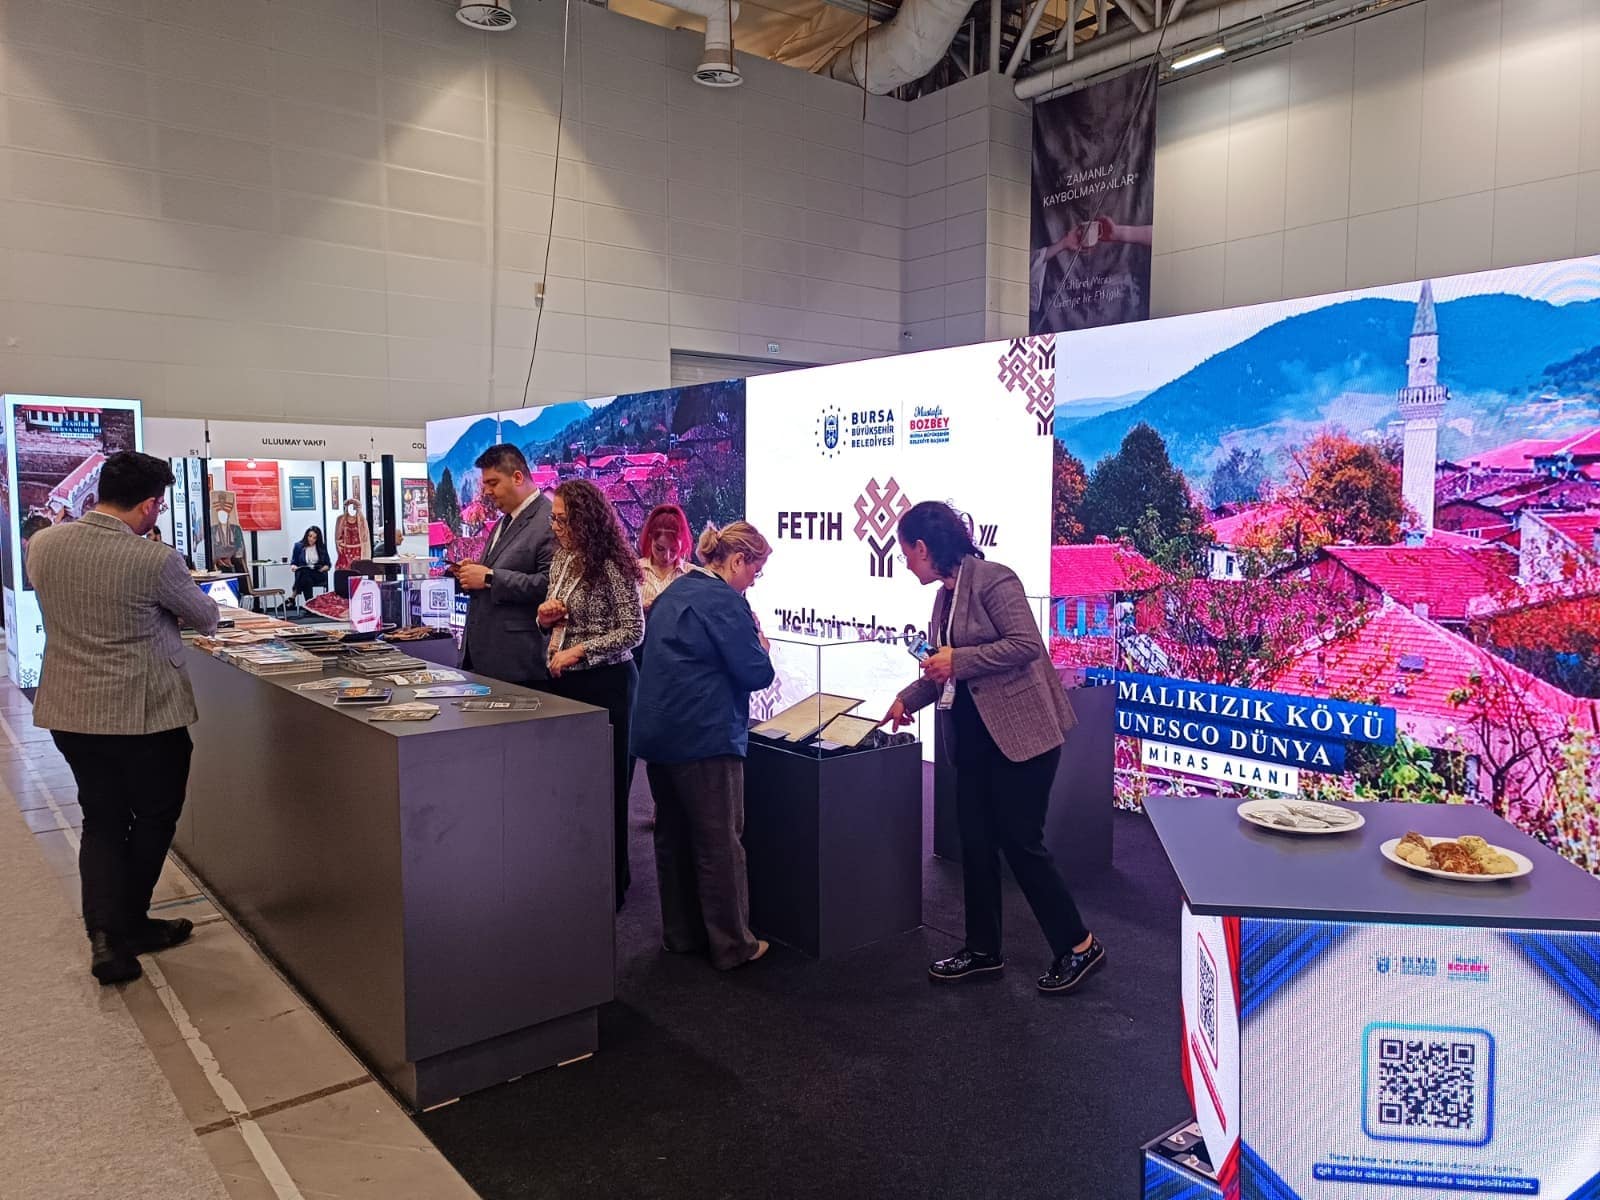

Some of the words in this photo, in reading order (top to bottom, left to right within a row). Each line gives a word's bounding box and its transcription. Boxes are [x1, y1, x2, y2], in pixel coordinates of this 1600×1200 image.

[851, 409, 894, 425] BURSA
[909, 417, 950, 430] BOZBEY
[851, 423, 895, 437] BÜYÜKŞEHİR
[261, 438, 301, 447] ULUUMAY
[303, 439, 326, 447] VAKFI
[851, 434, 895, 448] BELEDİYESİ
[777, 511, 842, 541] FETİH
[979, 524, 998, 547] YIL
[1286, 703, 1385, 740] KÖYÜ
[1118, 710, 1220, 745] UNESCO
[1230, 729, 1331, 767] DÜNYA
[1148, 746, 1209, 772] MİRAS
[1223, 761, 1291, 788] ALANI
